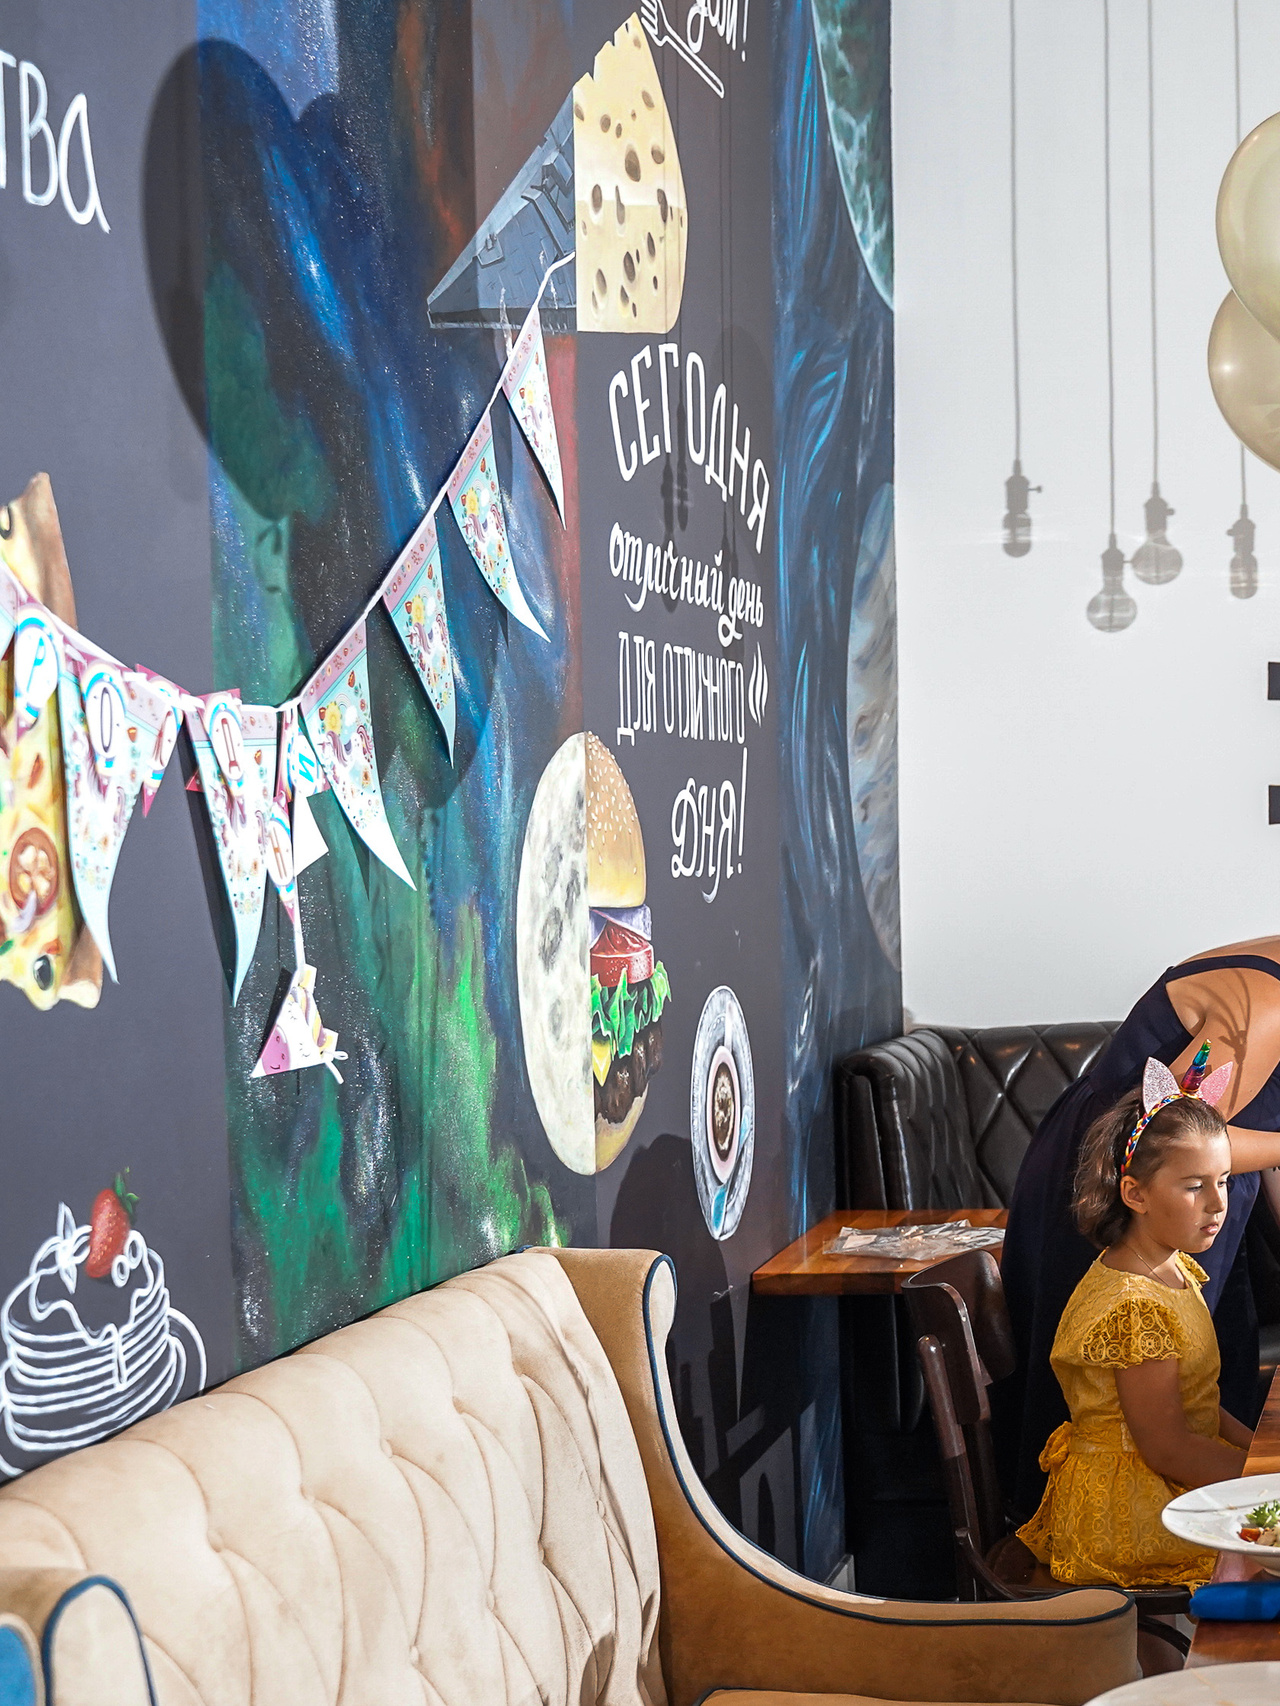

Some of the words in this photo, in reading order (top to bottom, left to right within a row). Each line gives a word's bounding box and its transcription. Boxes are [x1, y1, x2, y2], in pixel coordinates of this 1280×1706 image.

[608, 342, 770, 555] СЕГОДНЯ
[717, 576, 764, 648] день
[662, 642, 746, 745] ОТЛИЧНОГО
